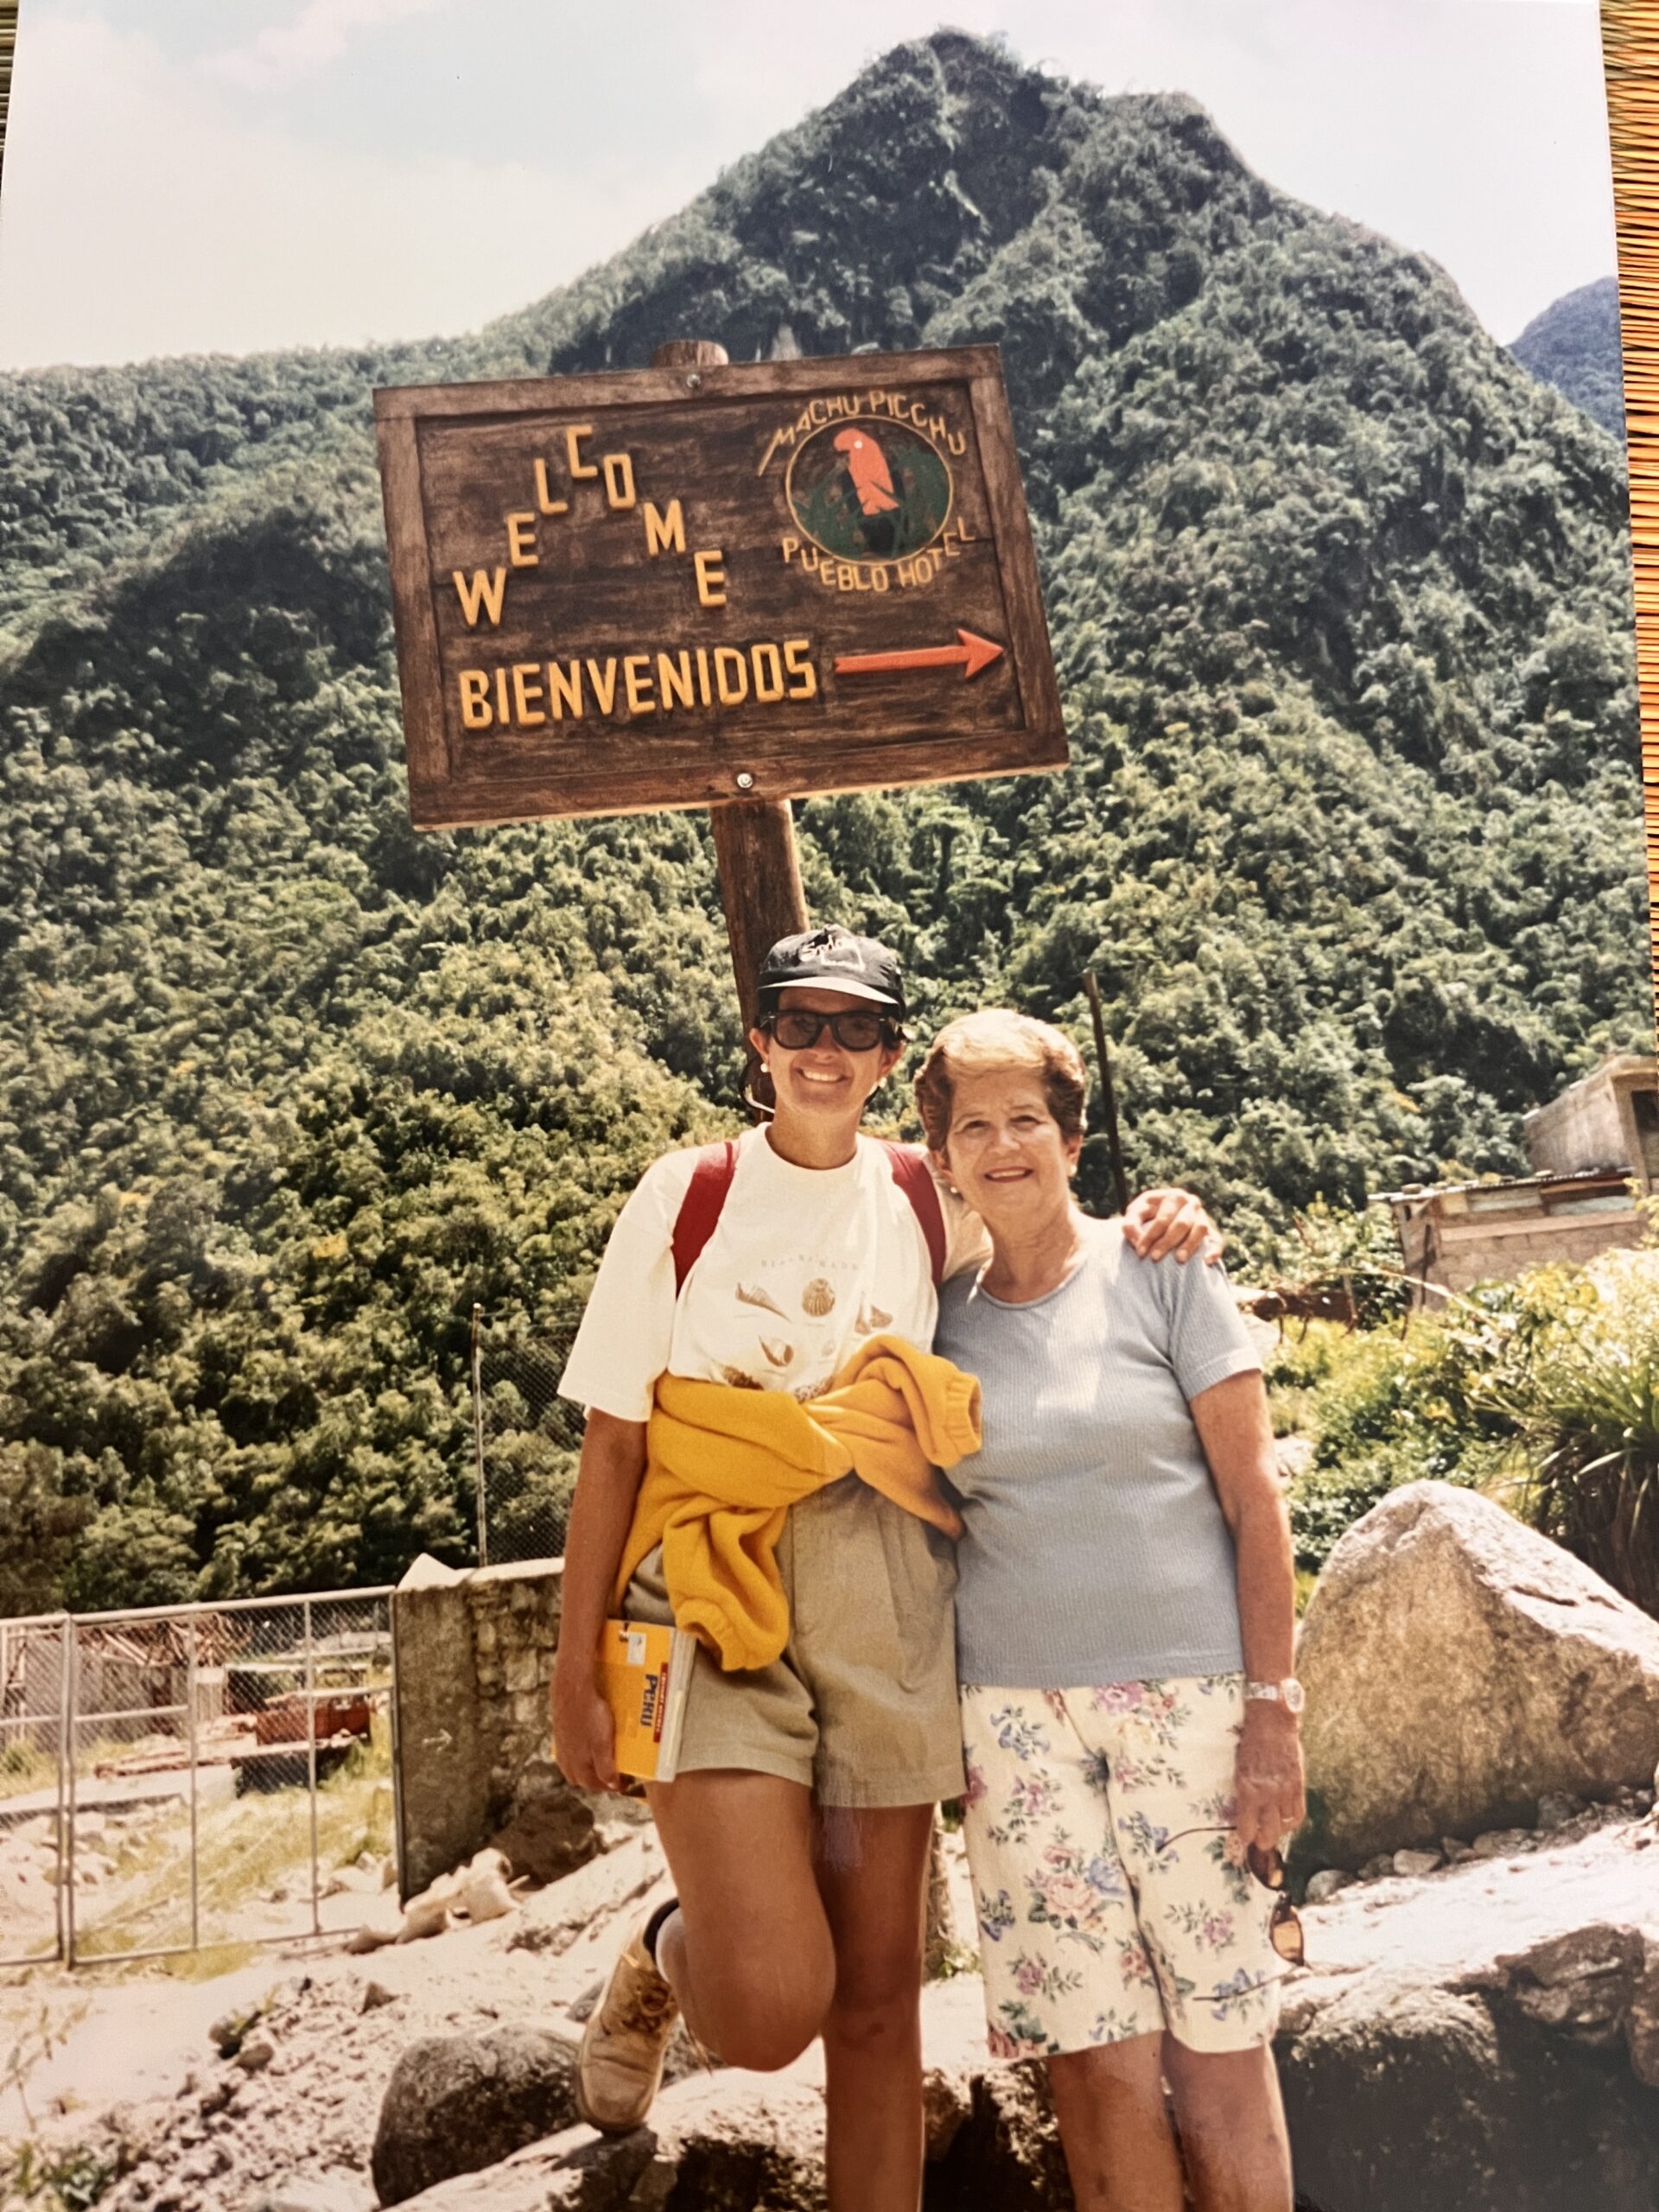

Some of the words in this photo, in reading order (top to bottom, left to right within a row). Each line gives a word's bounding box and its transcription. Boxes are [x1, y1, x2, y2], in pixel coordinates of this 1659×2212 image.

[758, 395, 861, 477] MACHU
[868, 391, 967, 455] PICCHU
[453, 425, 727, 627] WELCOME
[782, 537, 889, 593] PUEBLO
[898, 517, 976, 588] HOTEL
[458, 639, 817, 730] BIENVENIDOS
